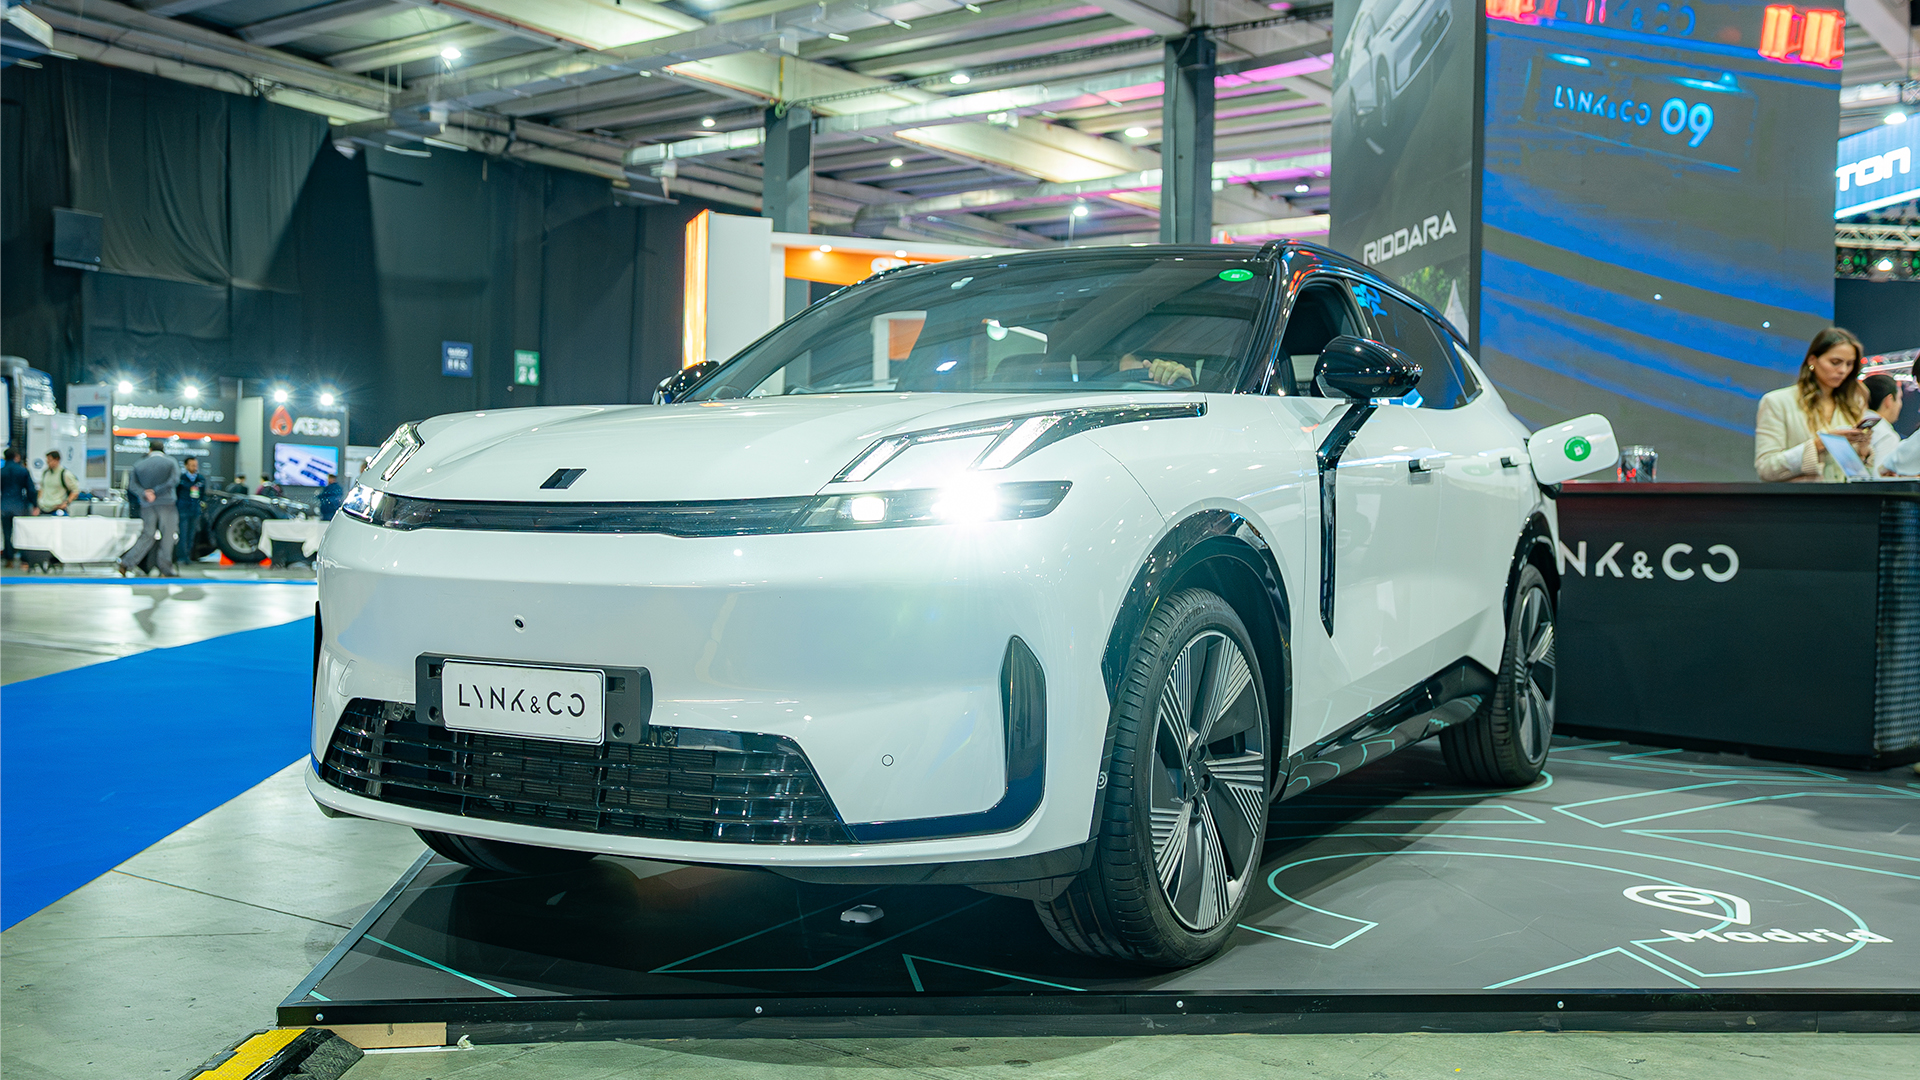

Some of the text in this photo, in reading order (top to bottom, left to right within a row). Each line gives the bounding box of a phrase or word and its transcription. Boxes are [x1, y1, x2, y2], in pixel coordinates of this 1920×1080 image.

[1660, 97, 1714, 148] 09
[1363, 209, 1458, 266] RIDDARA
[170, 406, 185, 420] el
[180, 406, 224, 423] futuro
[458, 683, 585, 717] LYNK&CO
[1660, 928, 1893, 943] Madrid
